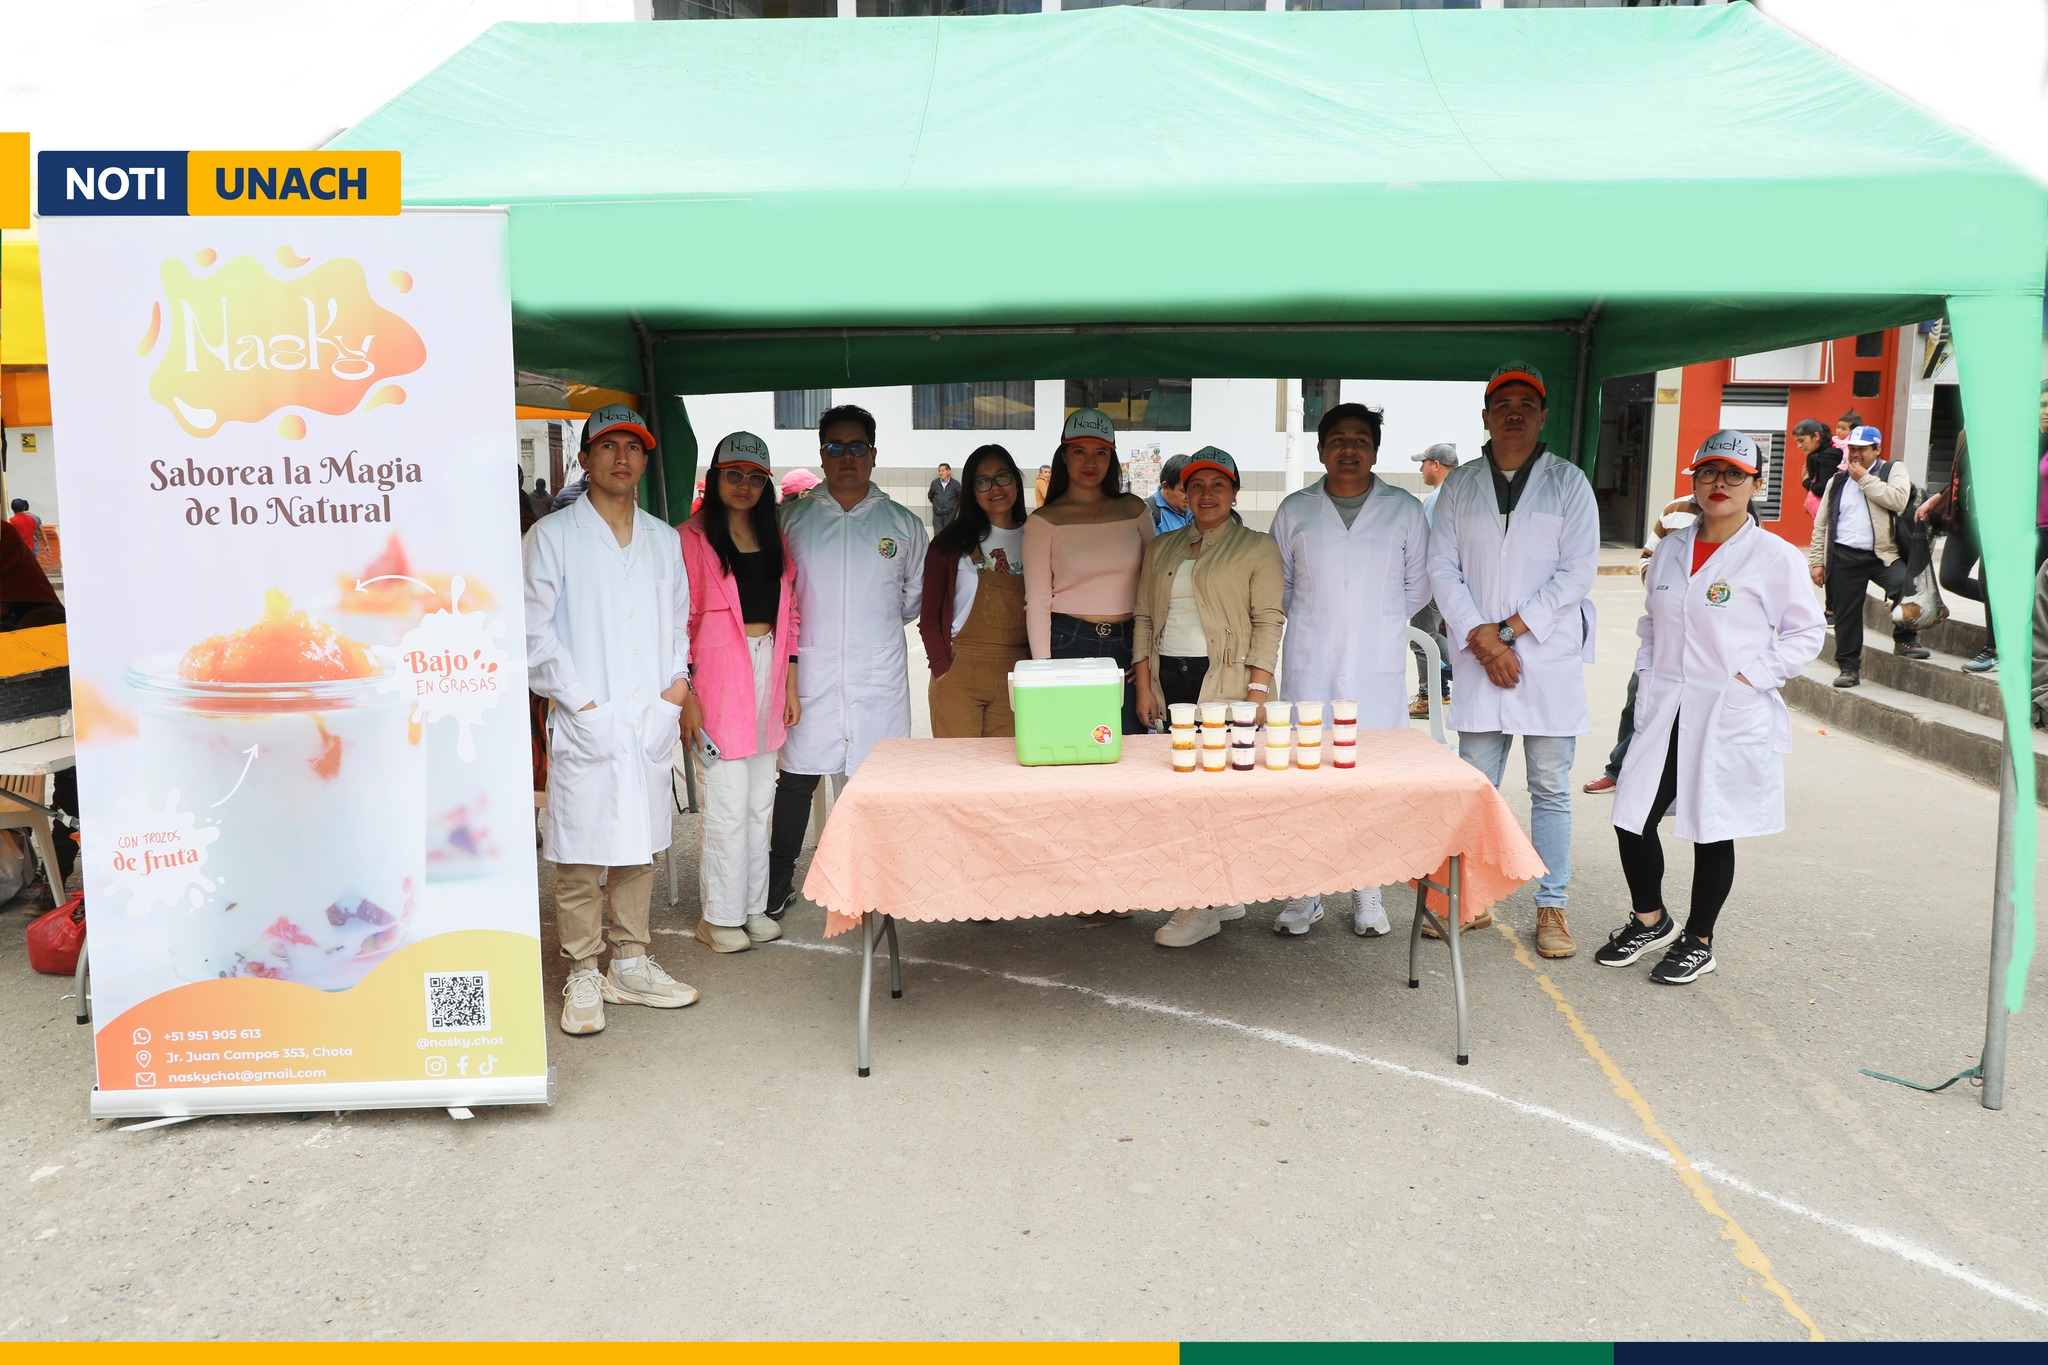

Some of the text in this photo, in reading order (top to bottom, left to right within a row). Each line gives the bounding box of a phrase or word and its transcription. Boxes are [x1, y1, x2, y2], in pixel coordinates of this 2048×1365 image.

[150, 450, 423, 492] Saborea la Magia
[185, 494, 392, 527] de lo Natural
[403, 649, 469, 678] Bajo
[416, 676, 497, 696] EN GRASAS
[118, 829, 181, 849] CON TROZOS
[112, 848, 199, 877] de fruta
[163, 1028, 262, 1042] +51 951 905 613
[416, 1035, 504, 1050] @nasky.chot
[166, 1046, 353, 1064] Jr. Juan Campos 353, Chota
[168, 1067, 327, 1084] naskychot@gmail.com
